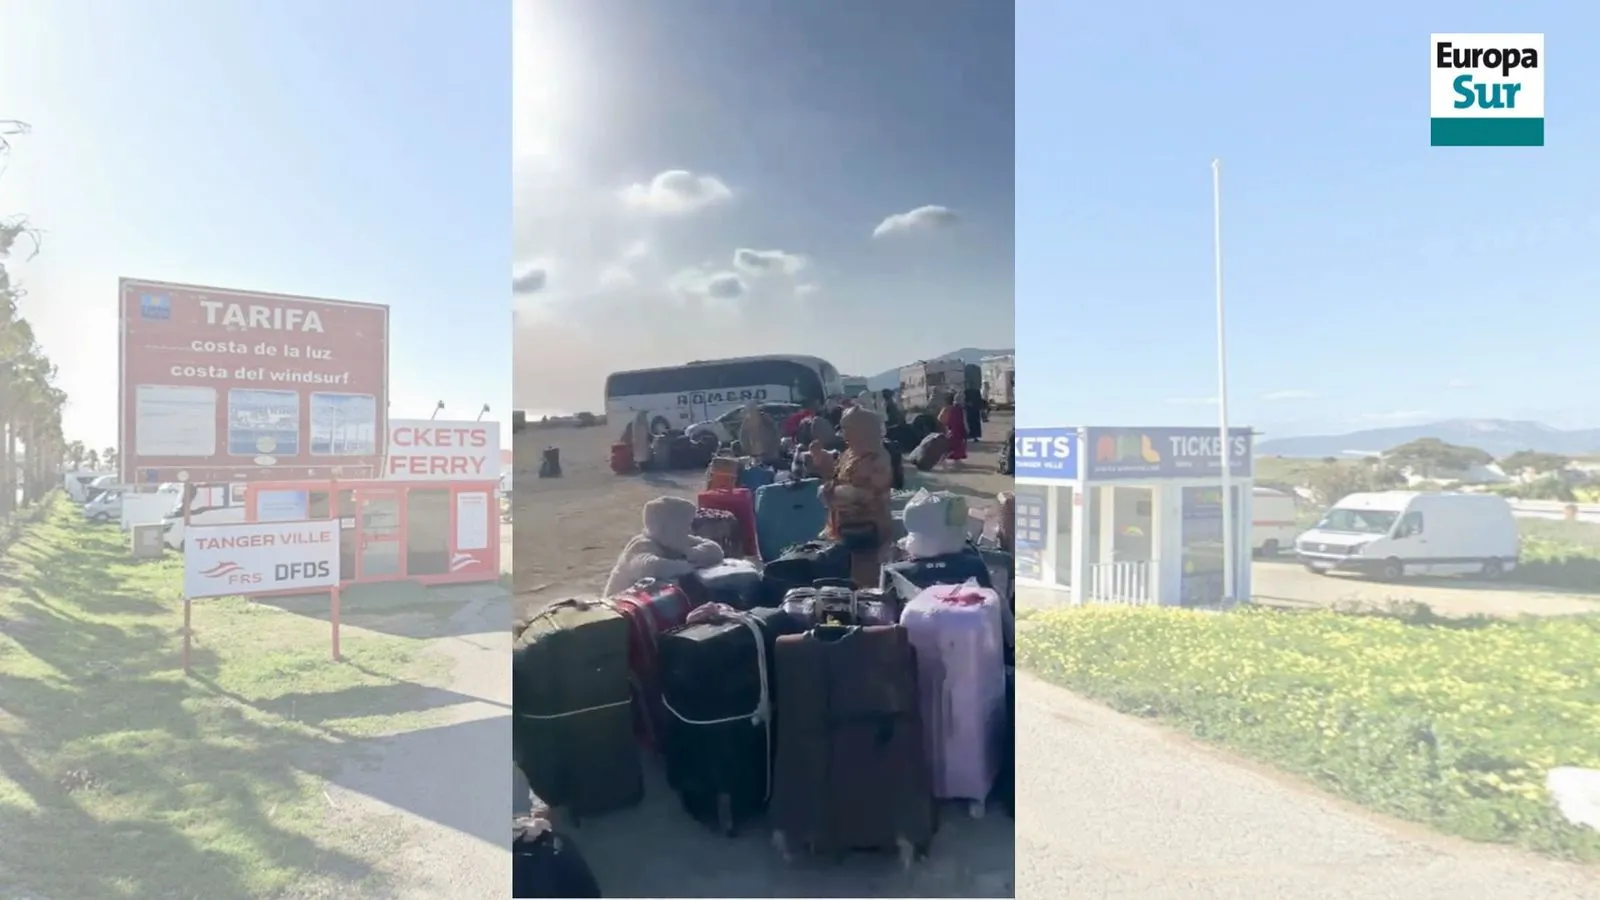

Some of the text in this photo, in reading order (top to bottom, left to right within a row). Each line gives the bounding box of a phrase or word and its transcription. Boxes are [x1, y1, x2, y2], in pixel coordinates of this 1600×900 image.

[201, 300, 324, 334] TARIFA
[191, 339, 332, 360] costa de la luz
[170, 363, 350, 385] costa del windsurf
[677, 389, 767, 405] ROMERO
[393, 427, 487, 447] CKETS
[390, 455, 486, 475] FERRY
[195, 530, 332, 551] TANGER VILLE
[228, 560, 330, 585] FRS DFDS
